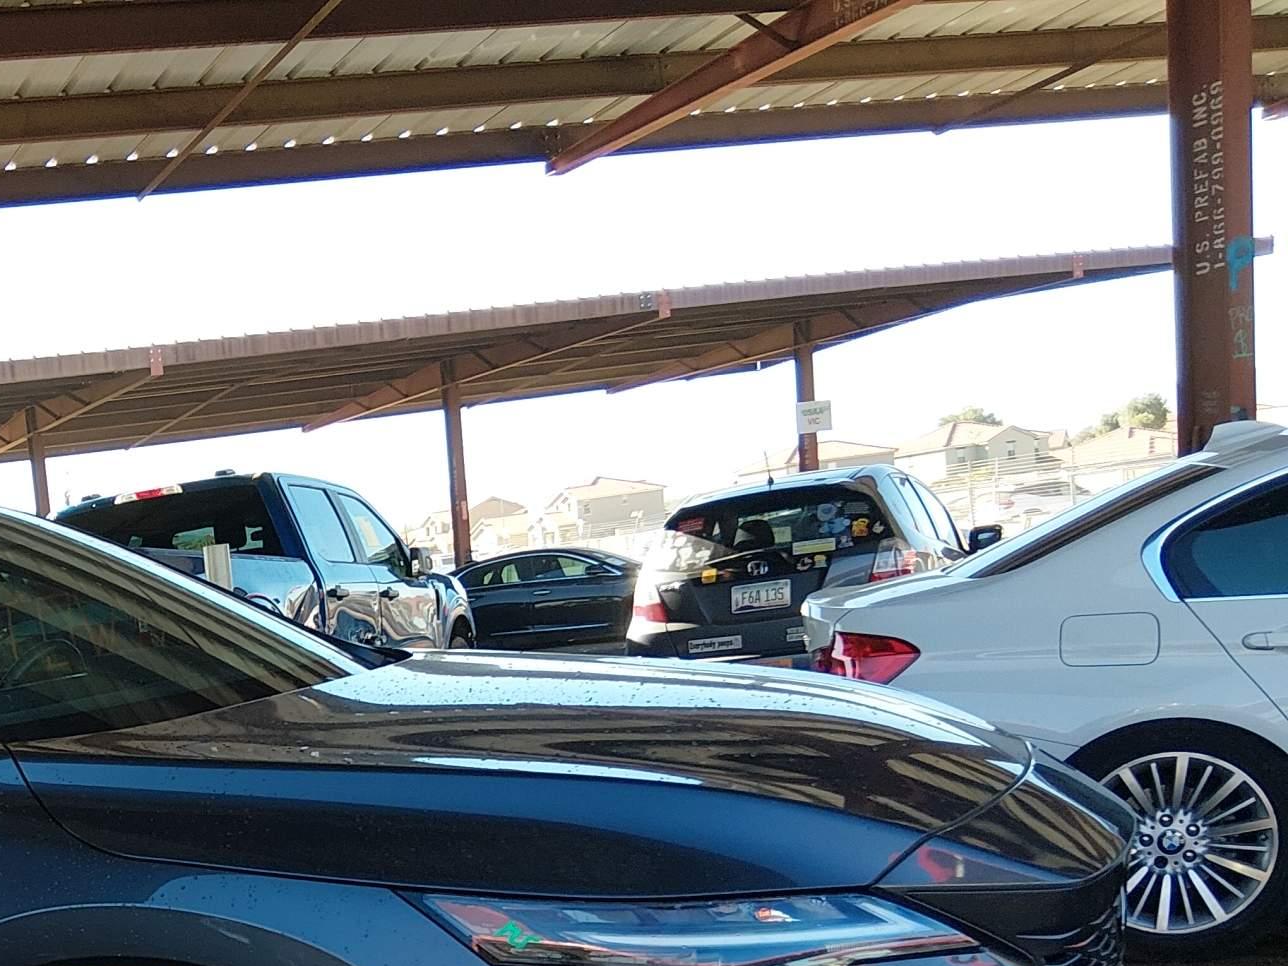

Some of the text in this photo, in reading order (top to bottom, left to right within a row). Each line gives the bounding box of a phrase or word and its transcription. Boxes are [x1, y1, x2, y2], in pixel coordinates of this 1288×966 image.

[1192, 84, 1210, 275] U.S. PREFAB INC.
[1226, 235, 1255, 291] P
